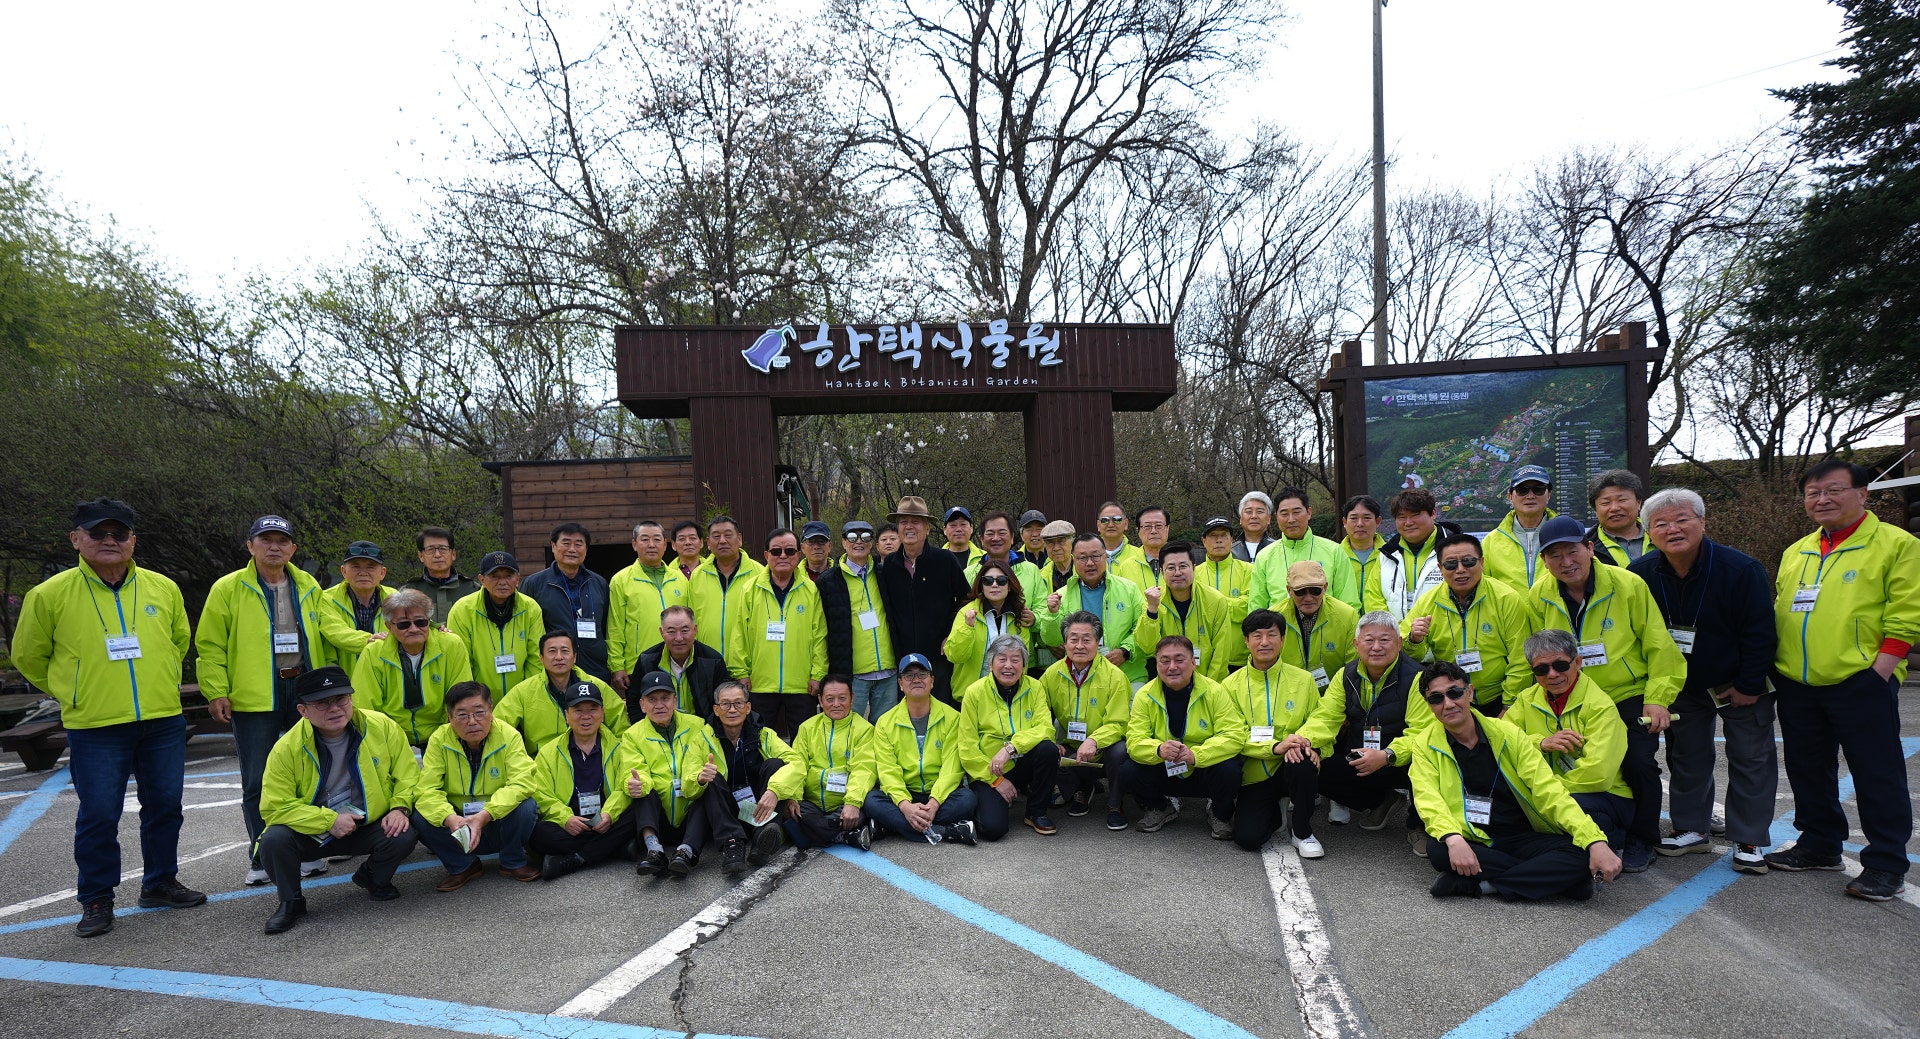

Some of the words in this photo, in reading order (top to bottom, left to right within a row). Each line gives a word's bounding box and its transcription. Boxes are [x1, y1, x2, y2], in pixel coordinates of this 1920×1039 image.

[800, 319, 1063, 373] 한택식물원
[825, 378, 891, 389] Hantaek
[900, 377, 975, 387] Botanical
[986, 376, 1039, 386] Garden
[262, 519, 287, 528] PING
[578, 684, 591, 696] A
